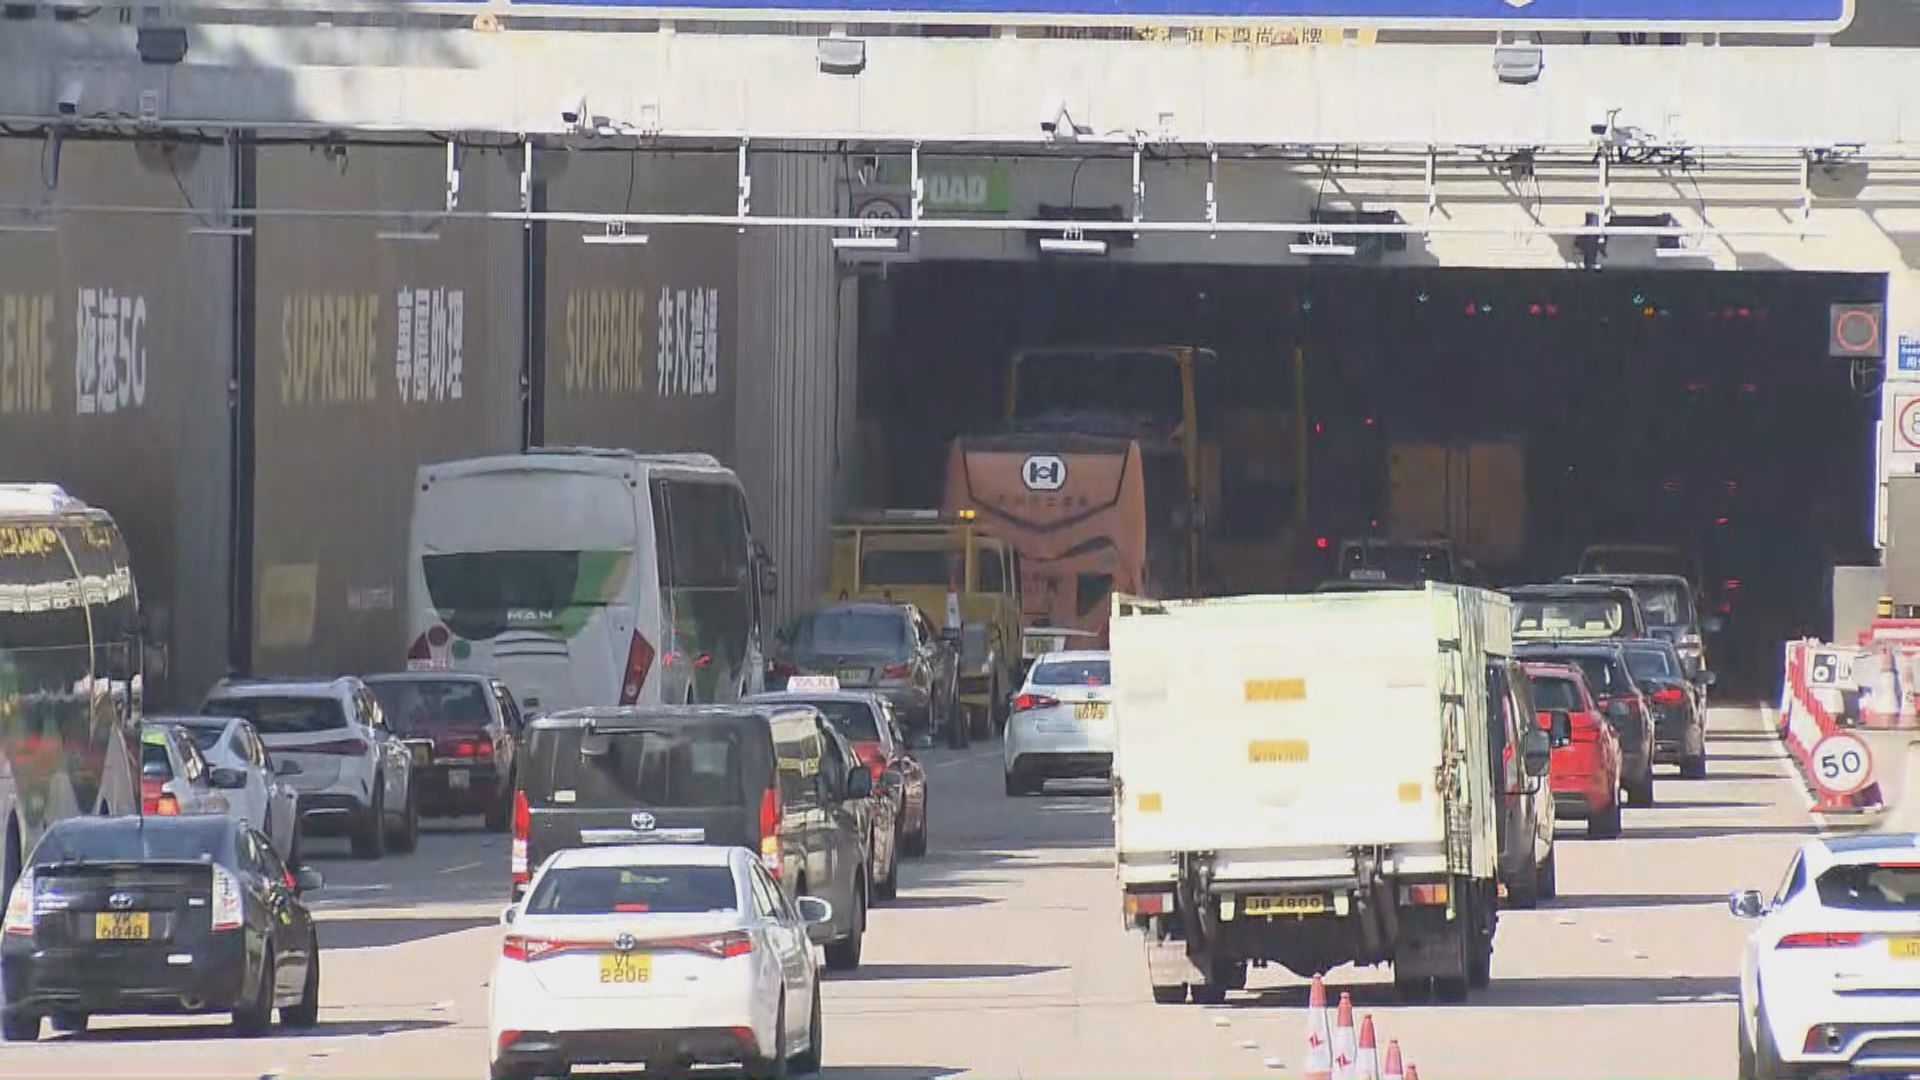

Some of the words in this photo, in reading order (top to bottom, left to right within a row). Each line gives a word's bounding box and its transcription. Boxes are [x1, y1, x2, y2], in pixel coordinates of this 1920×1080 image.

[281, 293, 378, 404] SUPREME
[564, 288, 644, 394] SUPREME
[507, 609, 553, 620] MAN
[793, 677, 834, 688] TAXI
[1822, 751, 1861, 778] 50
